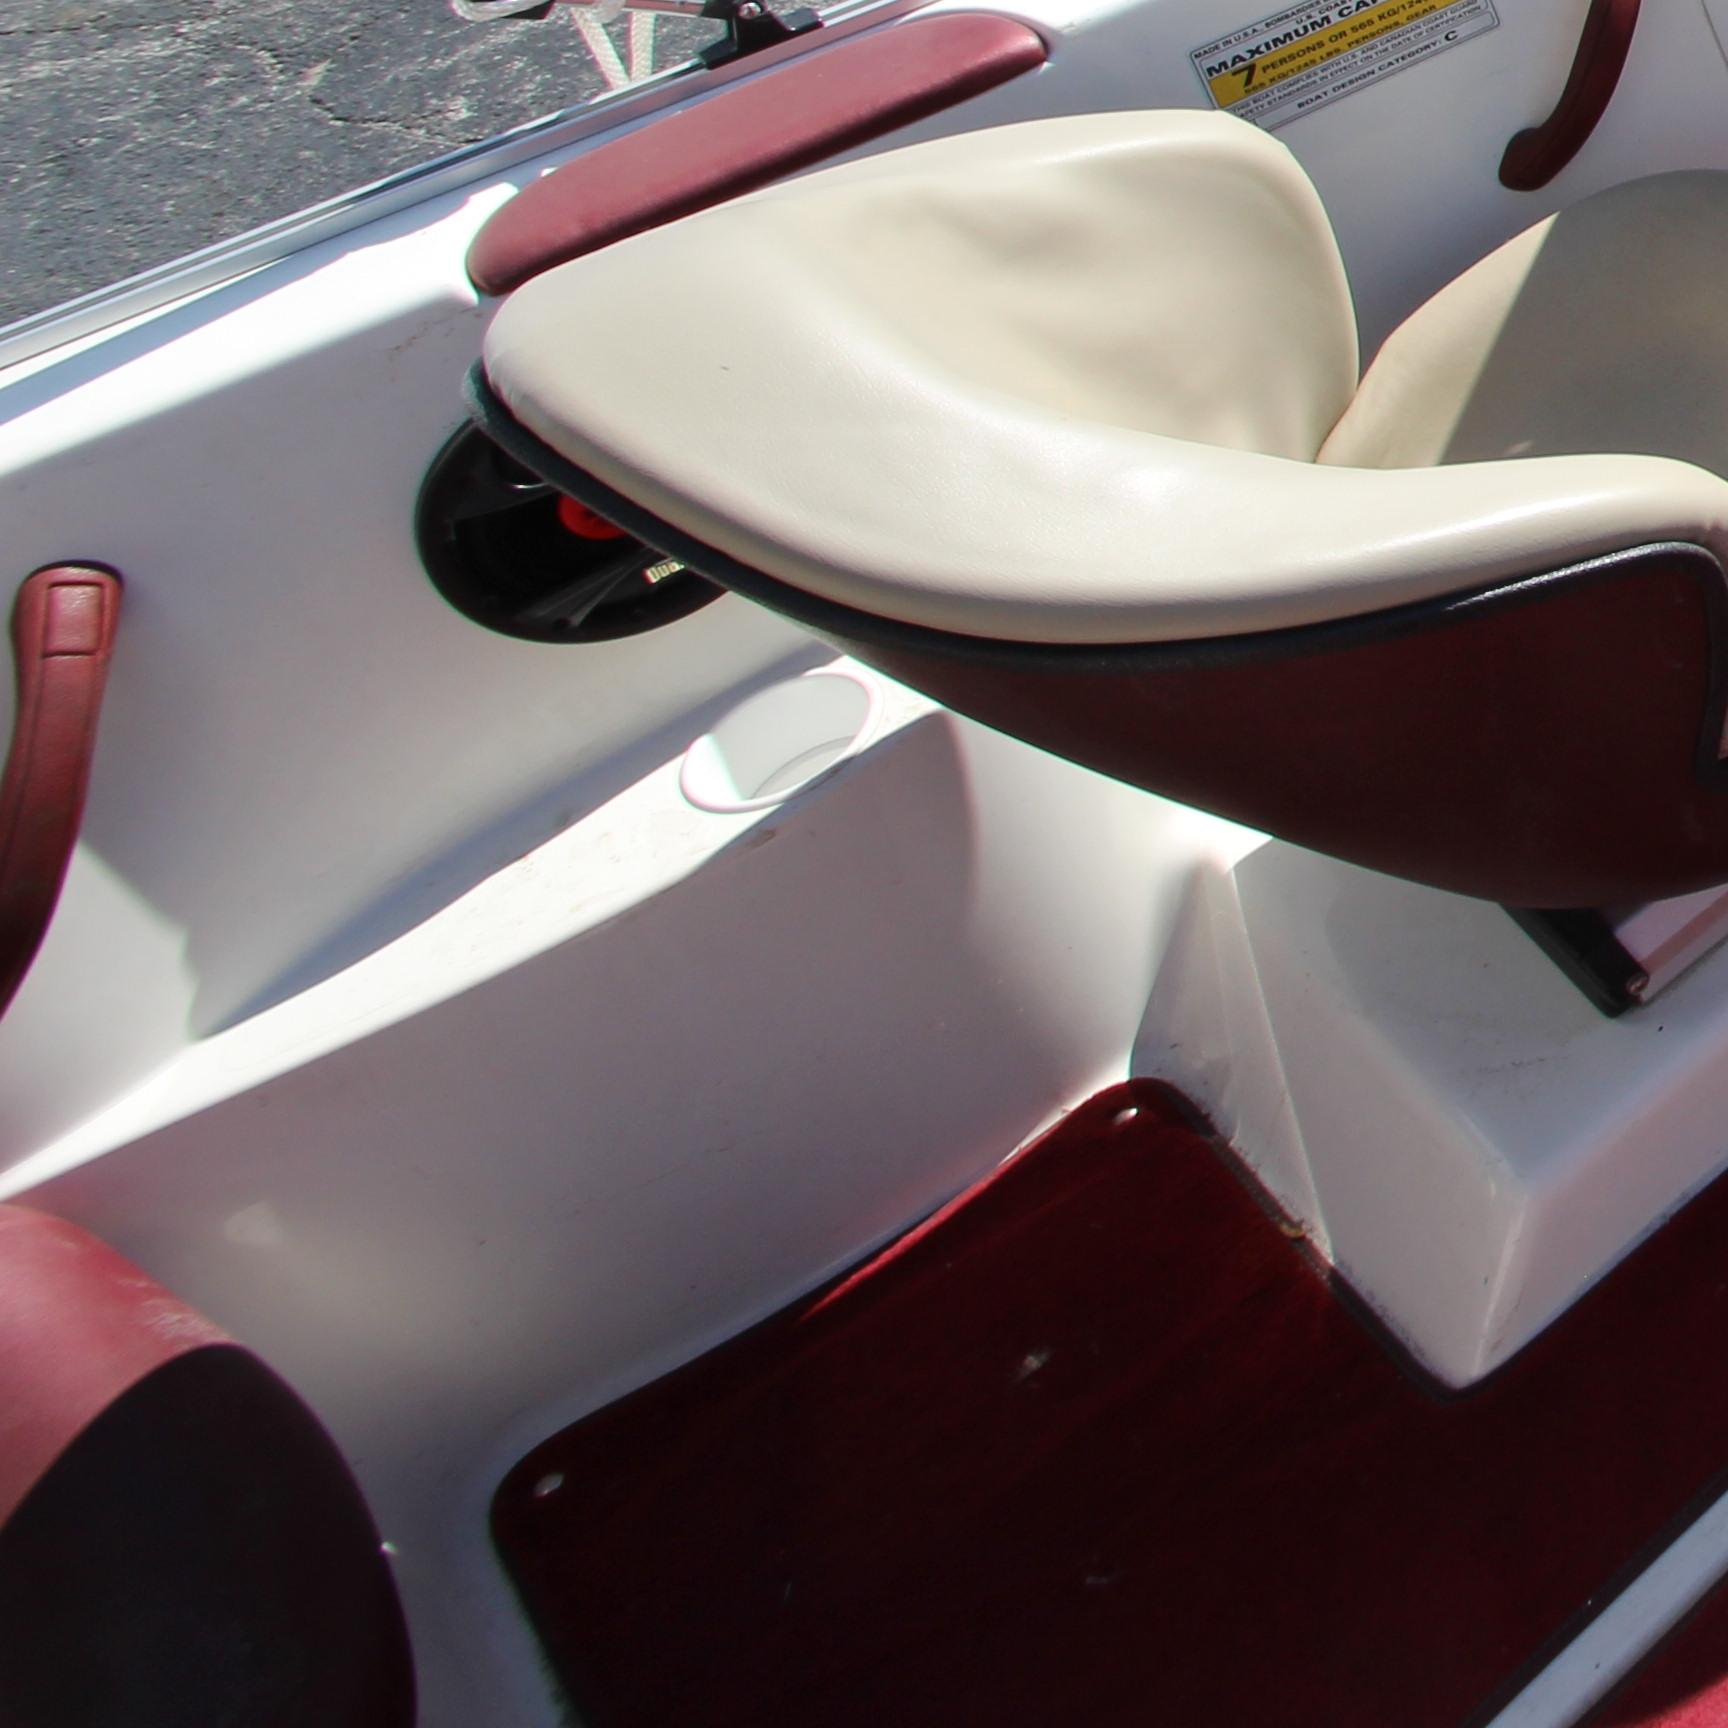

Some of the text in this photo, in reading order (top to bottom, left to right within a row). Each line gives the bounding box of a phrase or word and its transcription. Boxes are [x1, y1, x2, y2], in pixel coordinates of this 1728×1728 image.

[1193, 44, 1220, 60] MADE
[1221, 38, 1233, 47] IN
[1205, 14, 1333, 78] MAXIMUM
[1230, 62, 1264, 91] 7
[1260, 39, 1326, 74] PERSONS
[1327, 29, 1349, 44] OR
[1296, 90, 1330, 110] BOAT
[1331, 69, 1377, 94] DESIGN
[1442, 28, 1460, 43] C
